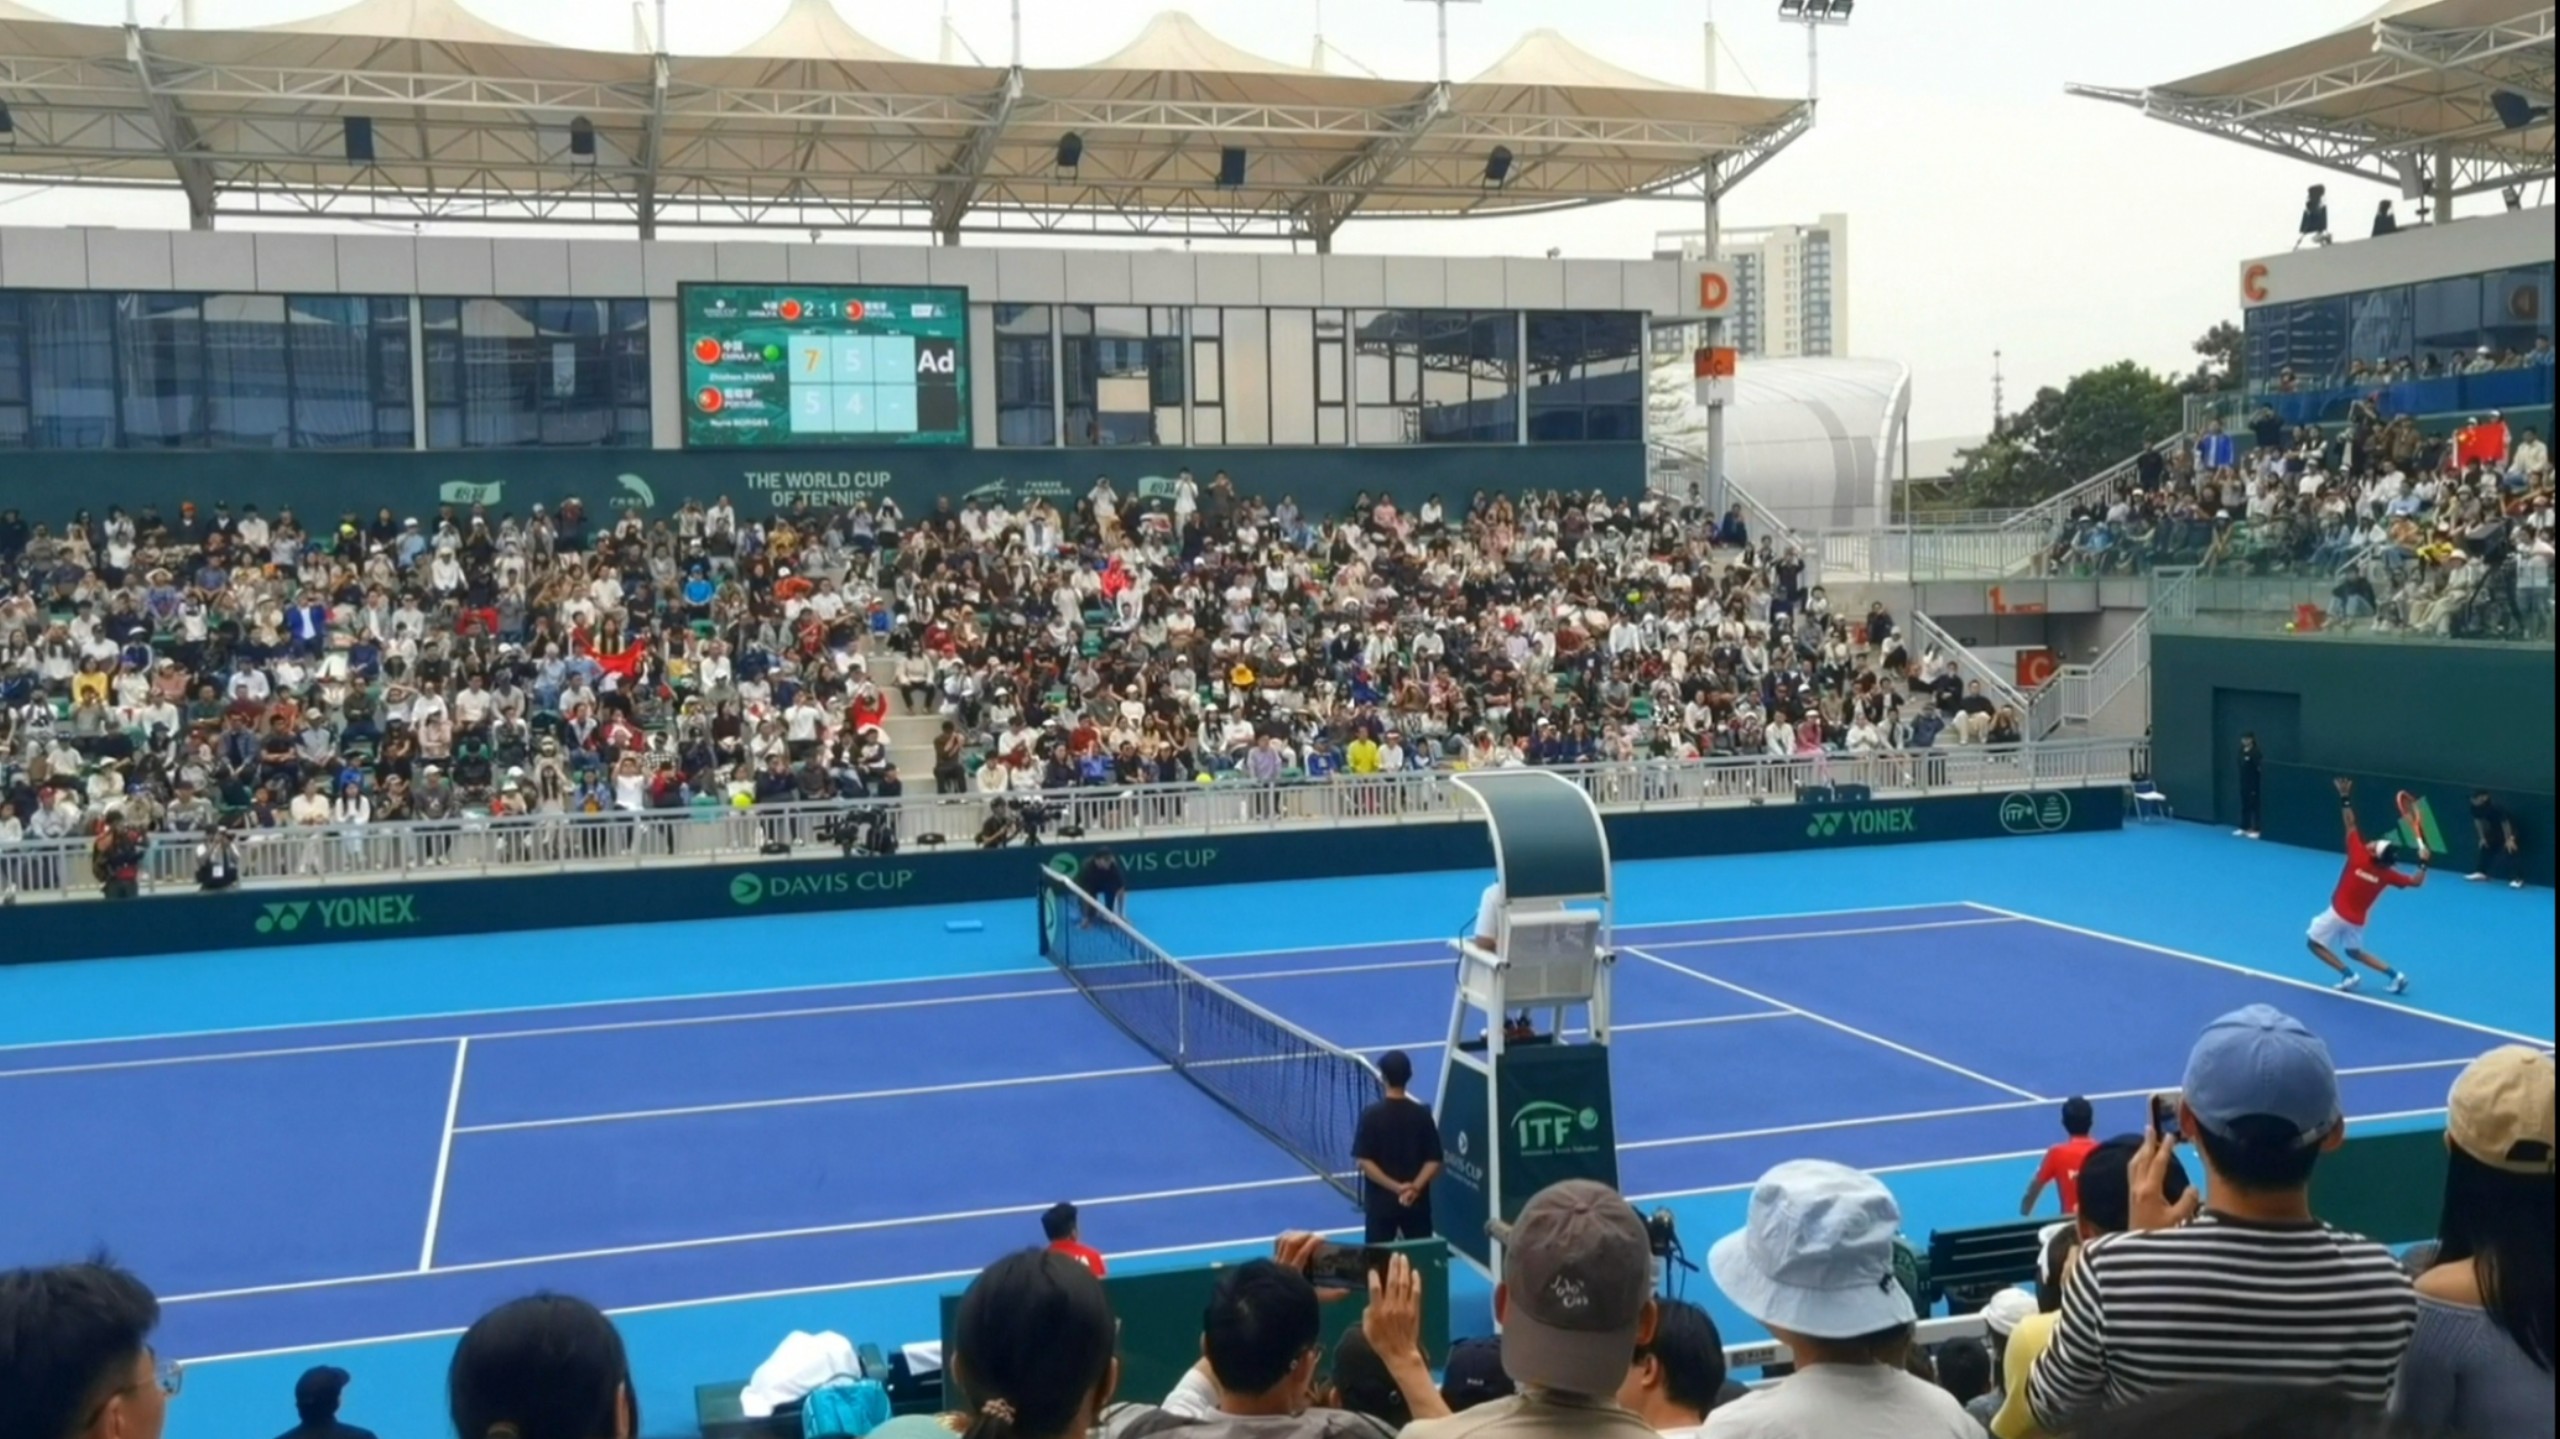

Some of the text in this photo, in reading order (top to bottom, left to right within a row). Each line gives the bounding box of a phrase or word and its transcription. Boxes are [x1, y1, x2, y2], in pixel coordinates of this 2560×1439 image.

[1700, 273, 1728, 310] D
[2244, 264, 2268, 302] C
[805, 348, 820, 371] 7
[846, 349, 860, 371] 5
[918, 349, 954, 373] Ad
[806, 391, 820, 414] 5
[845, 392, 863, 414] 4
[744, 471, 891, 488] THE WORLD CUP
[772, 491, 796, 507] OF
[1849, 808, 1915, 833] YONEX
[1165, 848, 1217, 869] CUP
[770, 870, 912, 897] DAVIS CUP
[318, 894, 414, 928] YONEX
[1519, 1115, 1572, 1148] ITF
